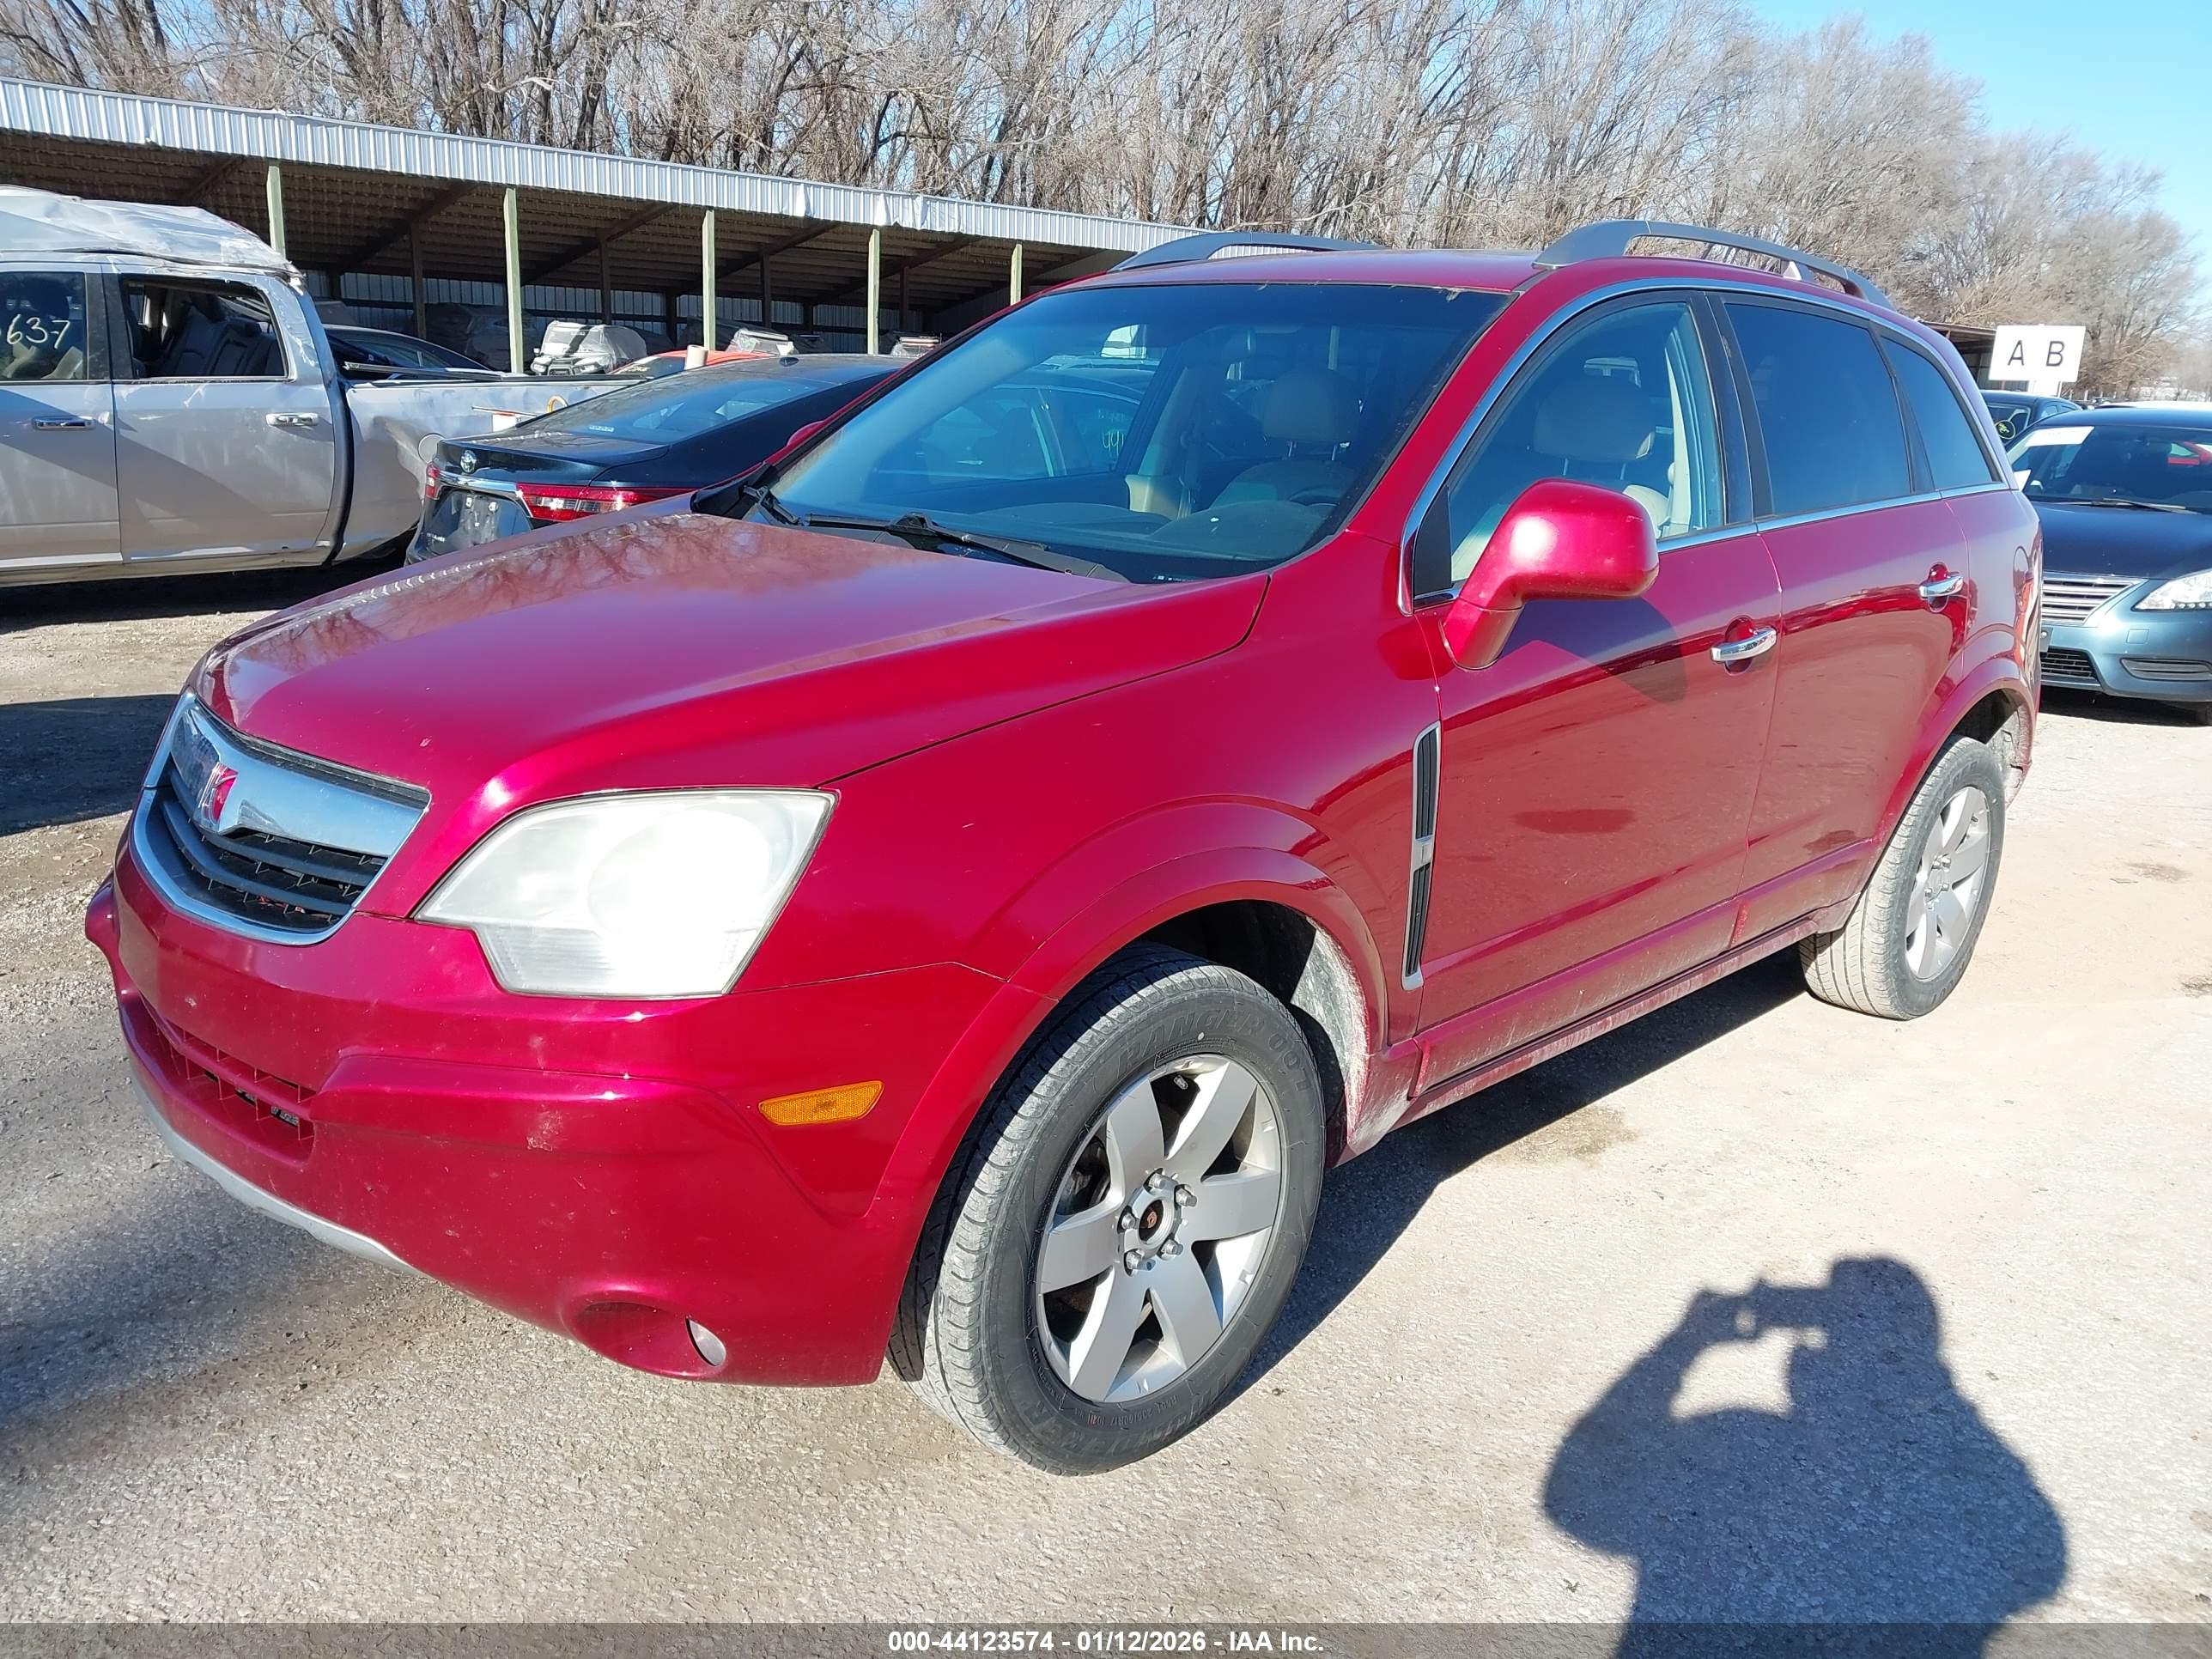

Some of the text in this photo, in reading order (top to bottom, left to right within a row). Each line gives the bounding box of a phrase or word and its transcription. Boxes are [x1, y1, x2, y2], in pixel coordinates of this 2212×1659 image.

[0, 313, 71, 349] 637
[2008, 340, 2065, 367] A B
